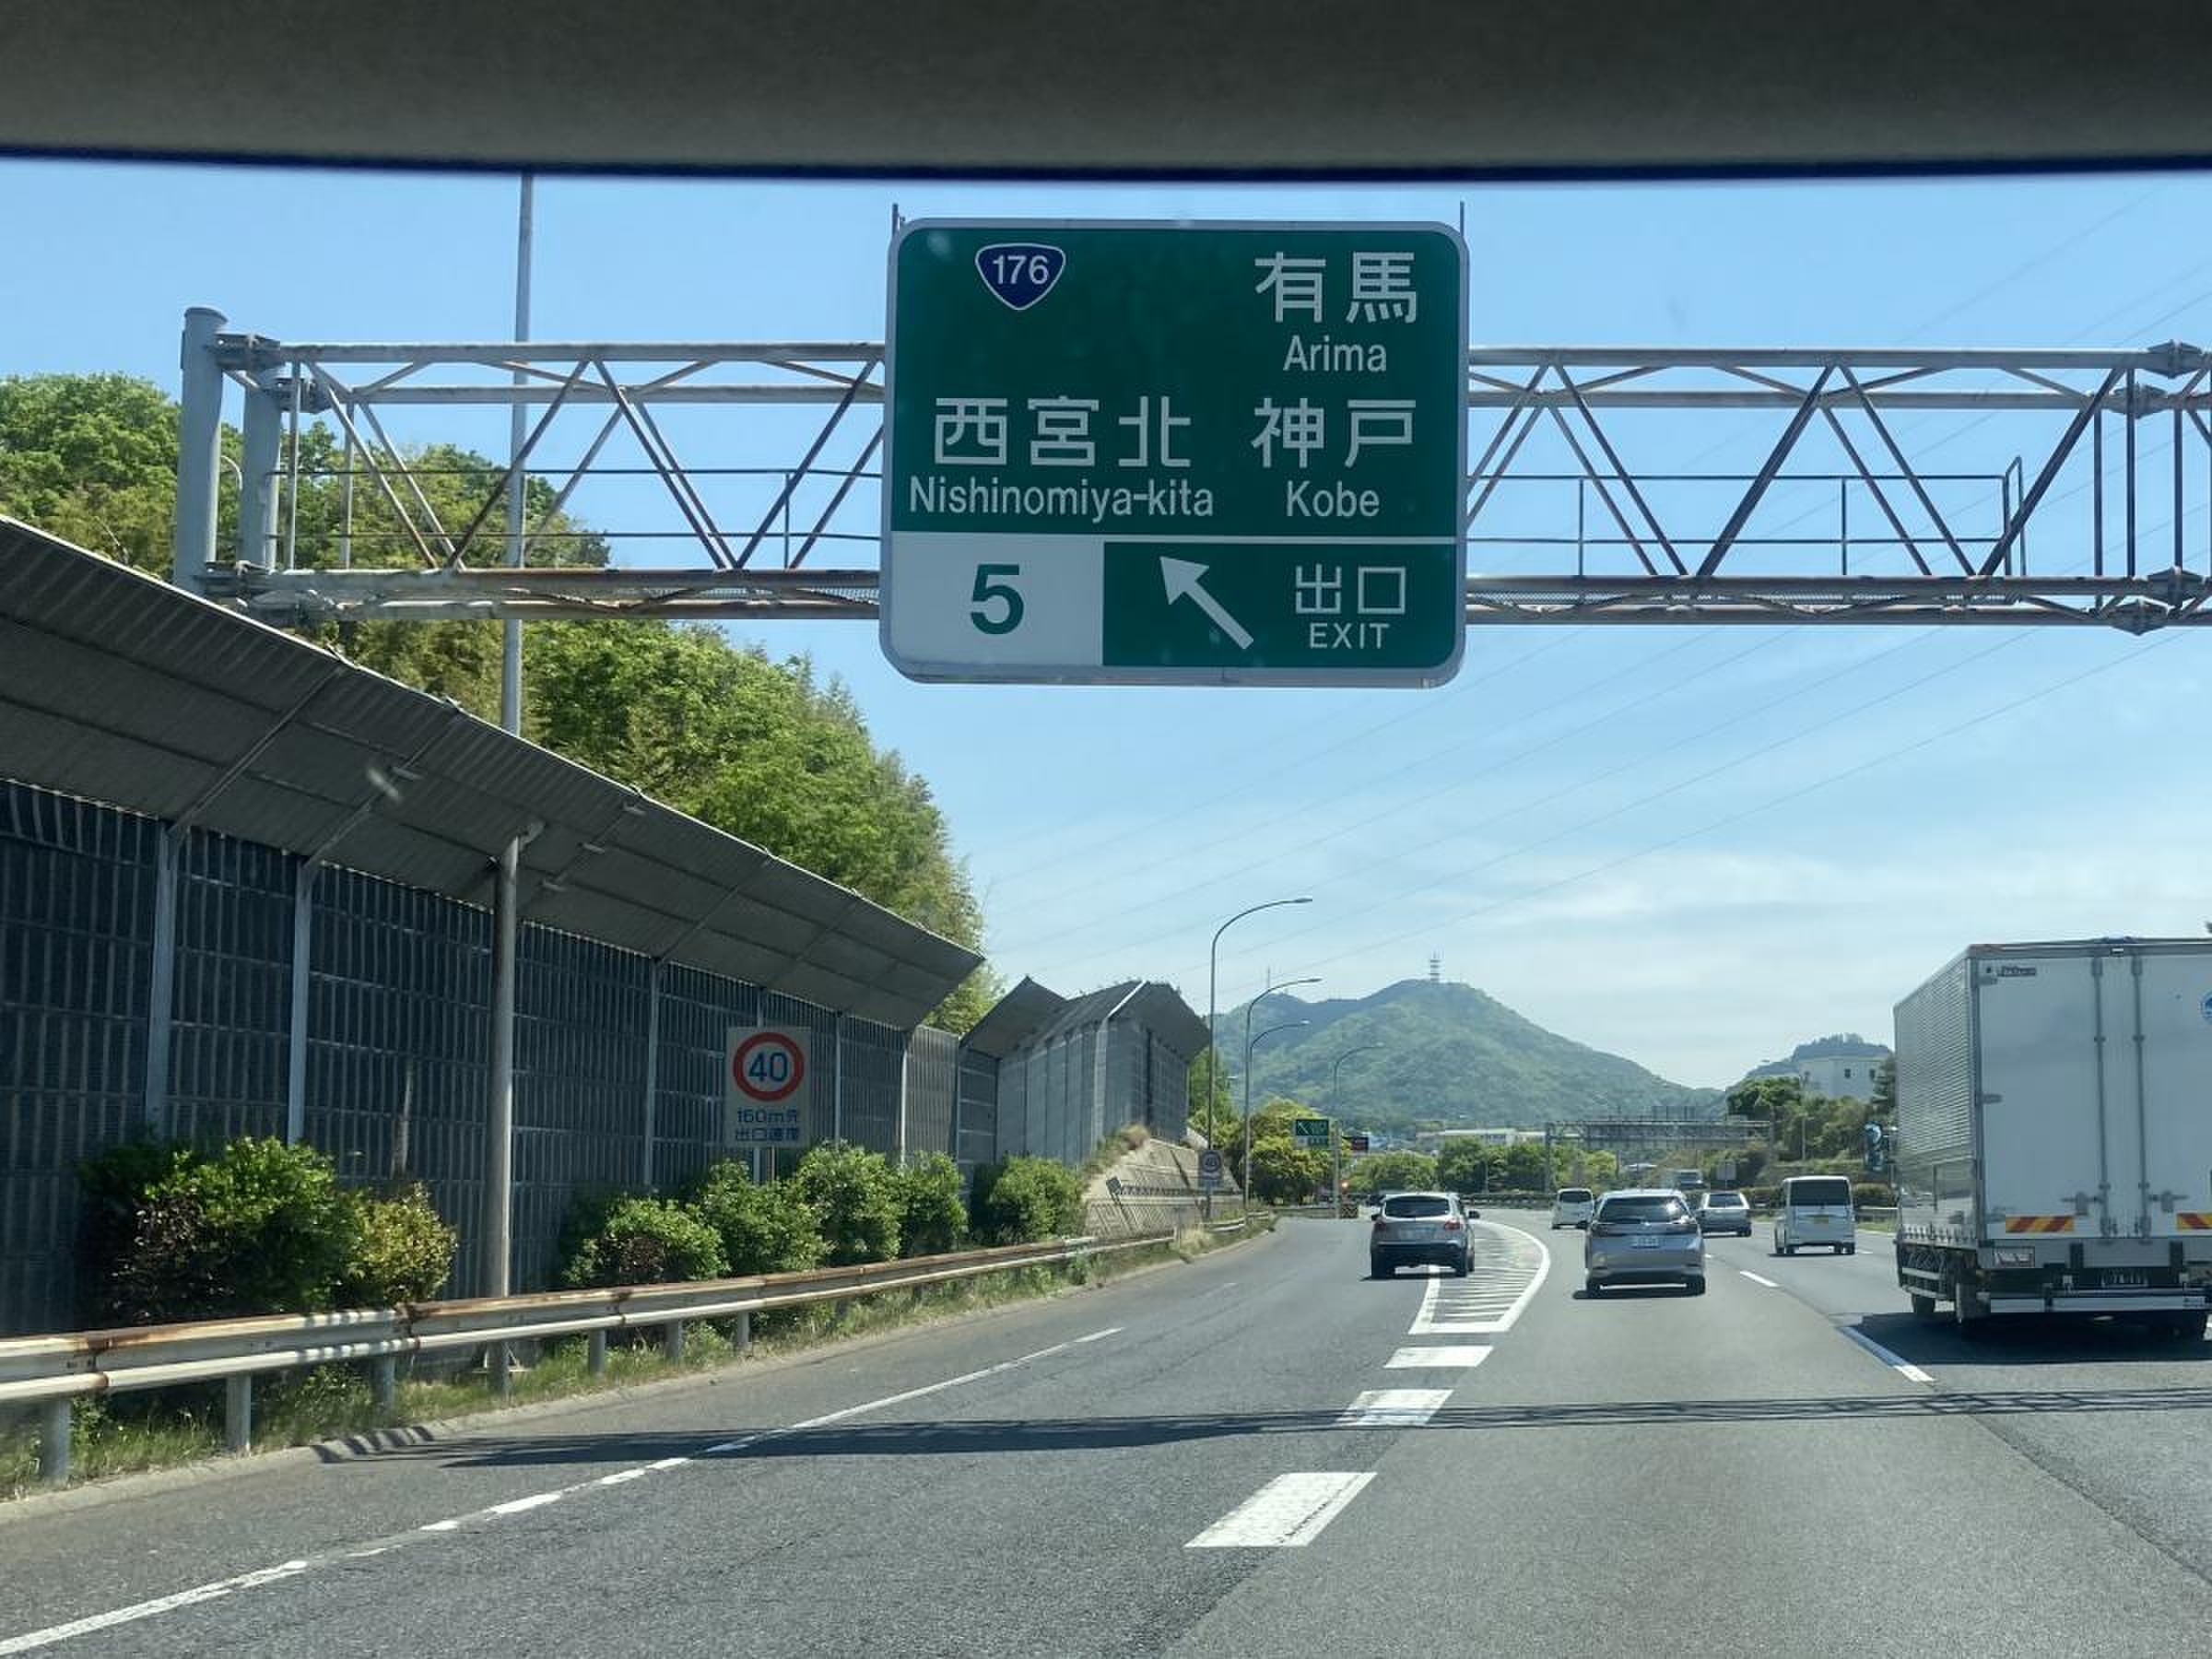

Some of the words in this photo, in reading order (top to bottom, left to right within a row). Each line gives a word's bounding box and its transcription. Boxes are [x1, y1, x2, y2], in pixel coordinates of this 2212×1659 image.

[992, 255, 1050, 285] 176
[1255, 252, 1417, 324] 有馬
[1282, 335, 1387, 372] Arima
[935, 395, 1191, 467] 西宮北
[1251, 397, 1417, 468] 神戸
[910, 476, 1213, 524] Nishinomiya-kita
[1287, 480, 1380, 517] Kobe
[970, 563, 1025, 635] 5
[1296, 564, 1406, 614] 出口
[1310, 623, 1389, 649] EXIT
[748, 1052, 788, 1082] 40
